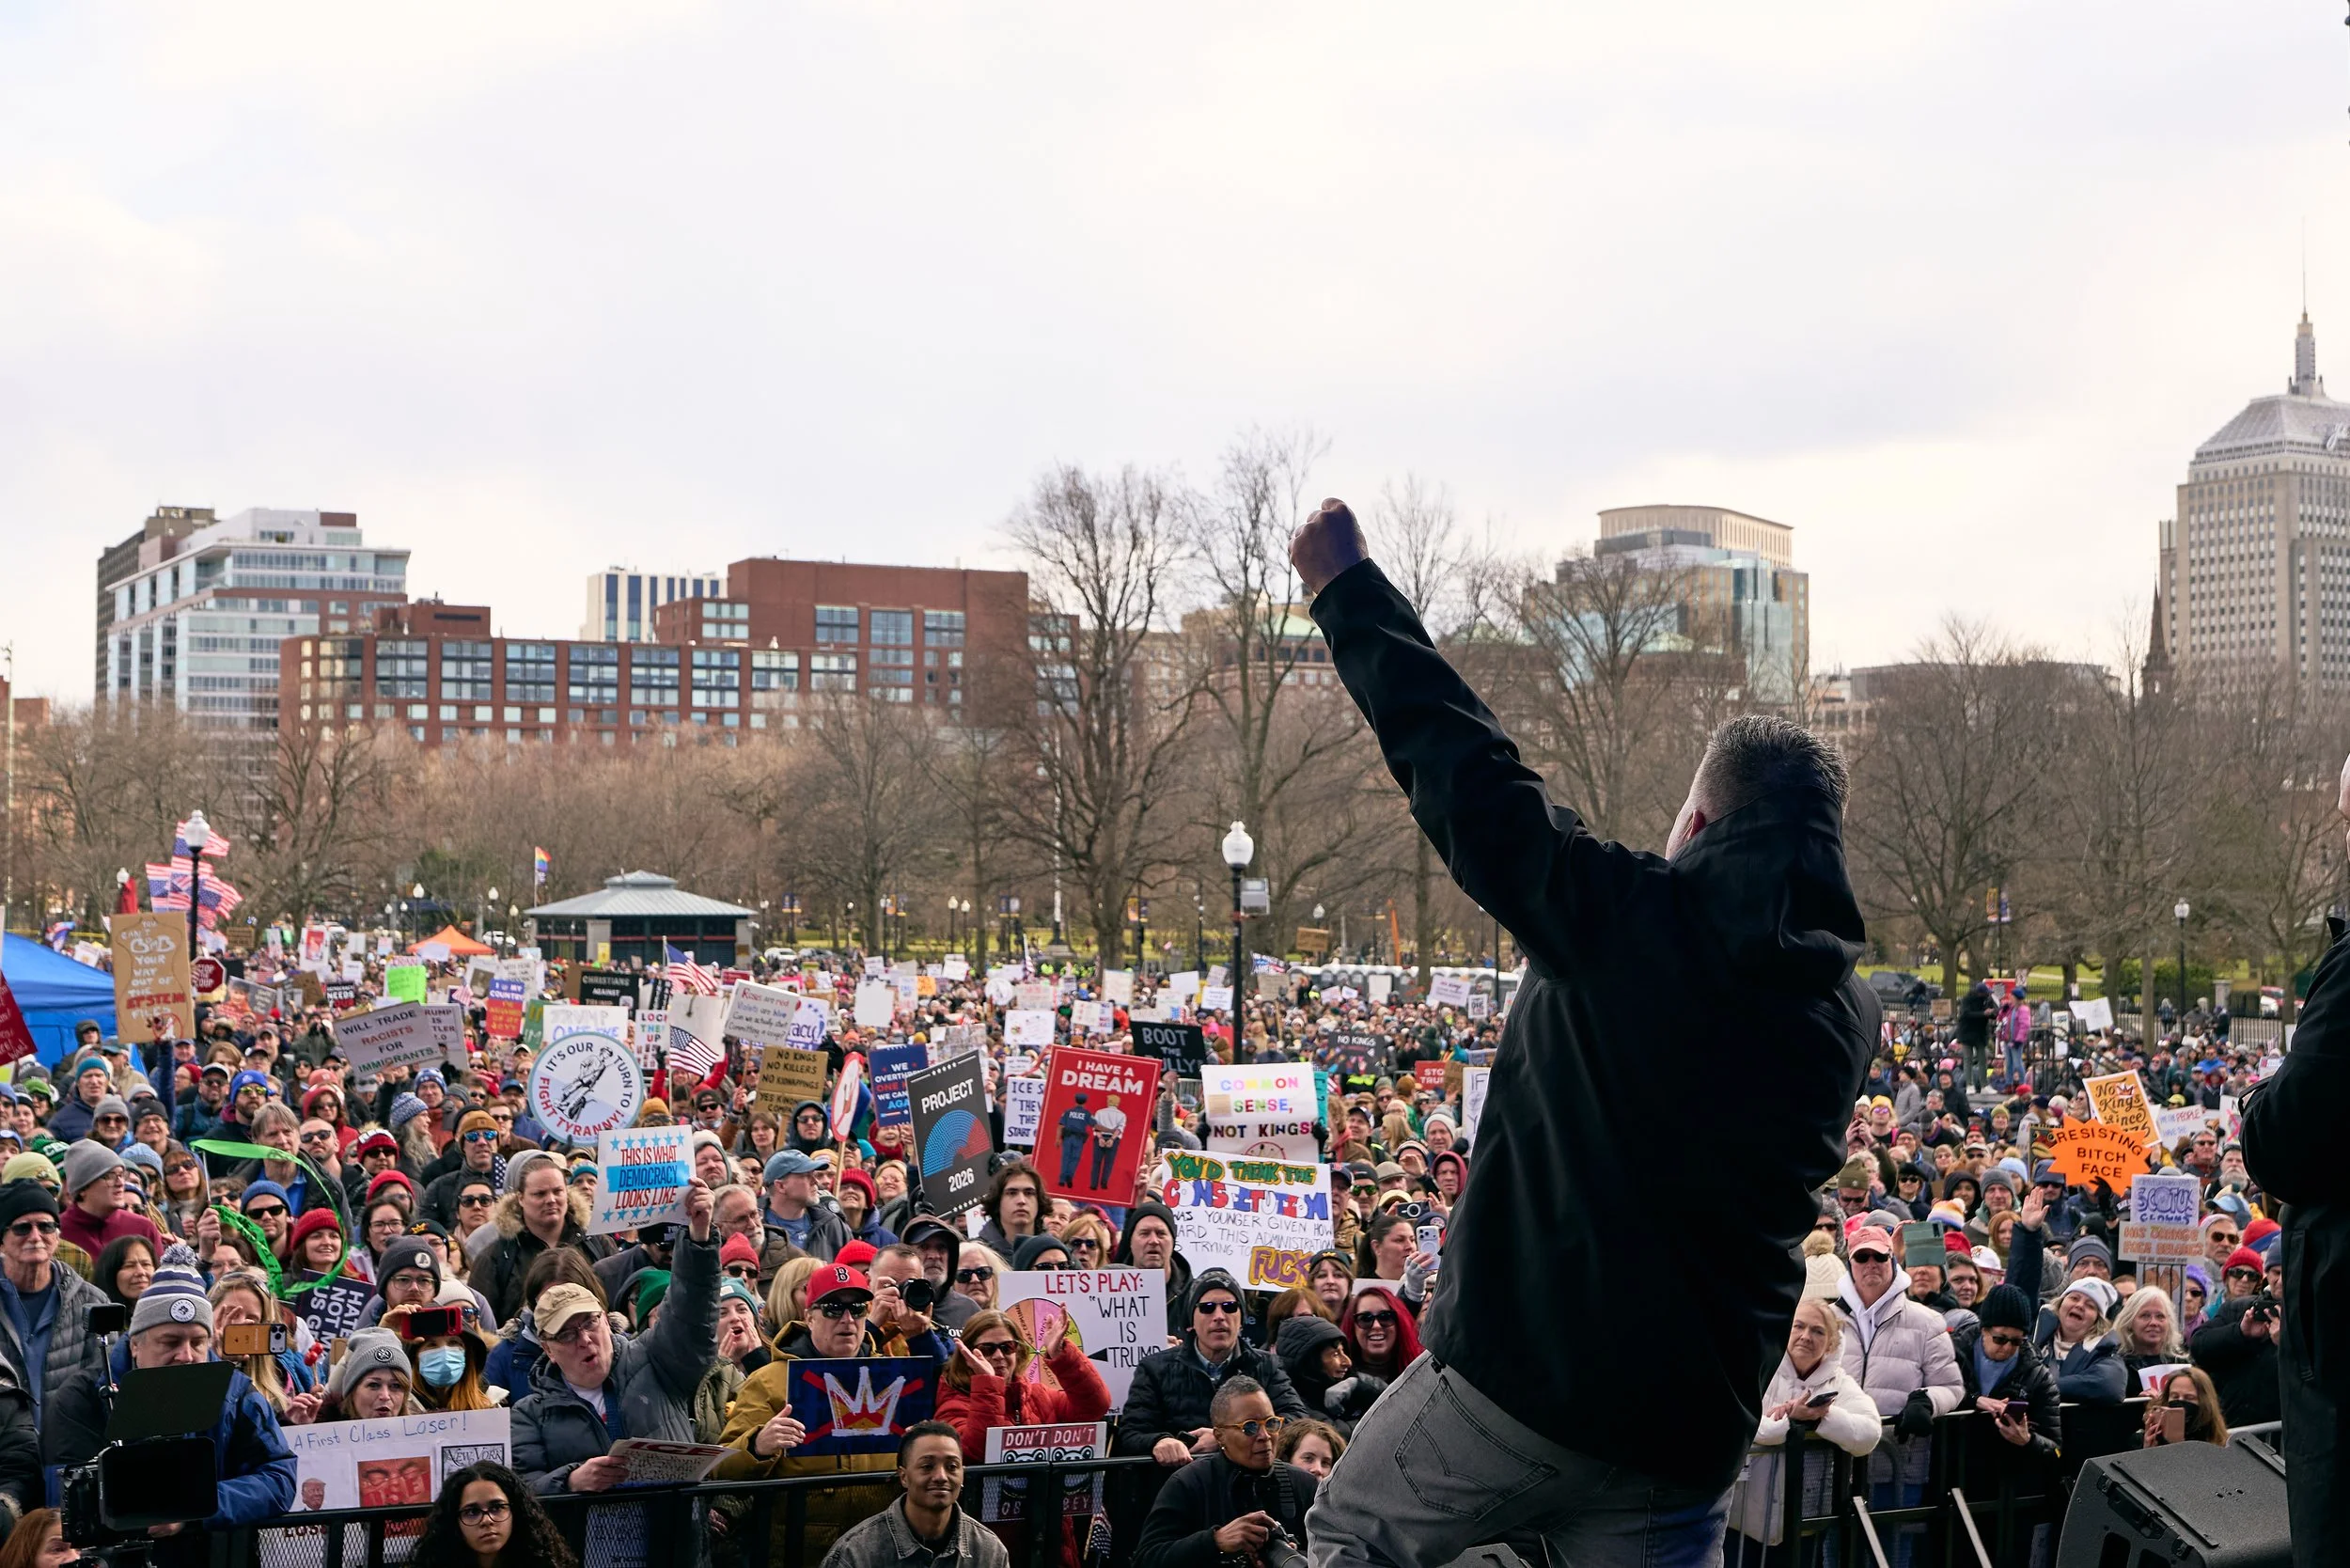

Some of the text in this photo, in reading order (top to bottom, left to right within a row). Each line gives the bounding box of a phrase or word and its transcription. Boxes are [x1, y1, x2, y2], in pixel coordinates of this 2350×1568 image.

[135, 955, 166, 964] YOUR
[133, 968, 158, 977] WAY
[582, 975, 630, 987] CHRISTIANS
[326, 990, 355, 999] NEEDS
[490, 990, 524, 1000] COUNTRY
[592, 988, 621, 997] AGAINST
[741, 988, 761, 1001] Roses
[776, 998, 790, 1007] red
[126, 993, 185, 1010] EPSTEIN
[132, 1007, 171, 1019] FILES
[551, 1009, 609, 1026] TRUMP
[737, 1002, 759, 1012] Violets
[773, 1010, 788, 1018] blue
[342, 1009, 417, 1035] WILL TRADE
[732, 1011, 744, 1020] Can
[754, 1017, 773, 1027] actually
[361, 1025, 415, 1045] RACISTS
[728, 1022, 760, 1038] Committing
[1142, 1027, 1188, 1046] BOOT
[378, 1041, 404, 1054] FOR
[1338, 1035, 1376, 1046] NO KINGS
[567, 1042, 594, 1056] OUR
[776, 1050, 817, 1062] NO KINGS
[1160, 1046, 1182, 1057] THE
[357, 1047, 439, 1073] IMMIGRANTS.
[544, 1050, 566, 1072] IT'S
[766, 1061, 817, 1074] NO KILLERS
[891, 1062, 908, 1072] WE
[613, 1055, 633, 1089] TURN
[1076, 1060, 1135, 1077] I HAVE A
[1423, 1068, 1444, 1076] STO
[761, 1074, 820, 1090] NO KIDNAPPINGS
[876, 1082, 899, 1091] ONE
[1011, 1081, 1033, 1094] ICE
[1061, 1070, 1144, 1096] DREAM
[1220, 1077, 1299, 1091] COMMON
[1420, 1075, 1444, 1084] TRU
[921, 1078, 975, 1114] PROJECT
[2095, 1078, 2127, 1098] No
[620, 1094, 633, 1108] TO
[760, 1092, 775, 1102] YES
[877, 1093, 891, 1102] WE
[887, 1099, 909, 1109] AGA
[2098, 1094, 2143, 1114] Kings
[538, 1076, 625, 1137] FIGHT TYRANNY!
[1233, 1098, 1293, 1114] SENSE,
[1069, 1111, 1086, 1121] POLICE
[1008, 1127, 1031, 1137] START
[1213, 1125, 1247, 1138] NOT
[2056, 1127, 2143, 1157] RESISTING
[620, 1145, 678, 1167] THIS IS WHAT
[2076, 1147, 2126, 1163] BITCH
[619, 1165, 678, 1187] DEMOCRACY
[1165, 1151, 1318, 1185] YOU'D THINK THE
[2081, 1164, 2123, 1179] FACE
[948, 1168, 975, 1193] 2026
[615, 1185, 679, 1210] LOOKS LIKE
[1163, 1179, 1329, 1220] CONSTITUTION
[2138, 1186, 2194, 1214] SCOTUS
[1204, 1210, 1262, 1228] YOUNGER
[1268, 1217, 1307, 1232] GIVEN
[1313, 1223, 1332, 1234] HOW
[1177, 1224, 1335, 1251] ARD THIS ADMINISTRATION
[2150, 1226, 2200, 1242] ORANGE
[1174, 1241, 1251, 1258] S TRYING TO
[835, 1266, 850, 1282] B
[1249, 1247, 1317, 1288] FUCK
[1045, 1273, 1144, 1294] LET'S PLAY:
[325, 1286, 348, 1328] NOT
[339, 1290, 364, 1338] HATE
[1089, 1295, 1151, 1318] "WHAT
[1119, 1321, 1136, 1343] IS
[293, 1413, 467, 1451] A First Class Loser!
[1005, 1431, 1047, 1447] DON'T
[1053, 1428, 1095, 1445] DON'T
[628, 1441, 726, 1456] ICE
[1001, 1501, 1023, 1515] OB
[1062, 1495, 1091, 1511] BEY
